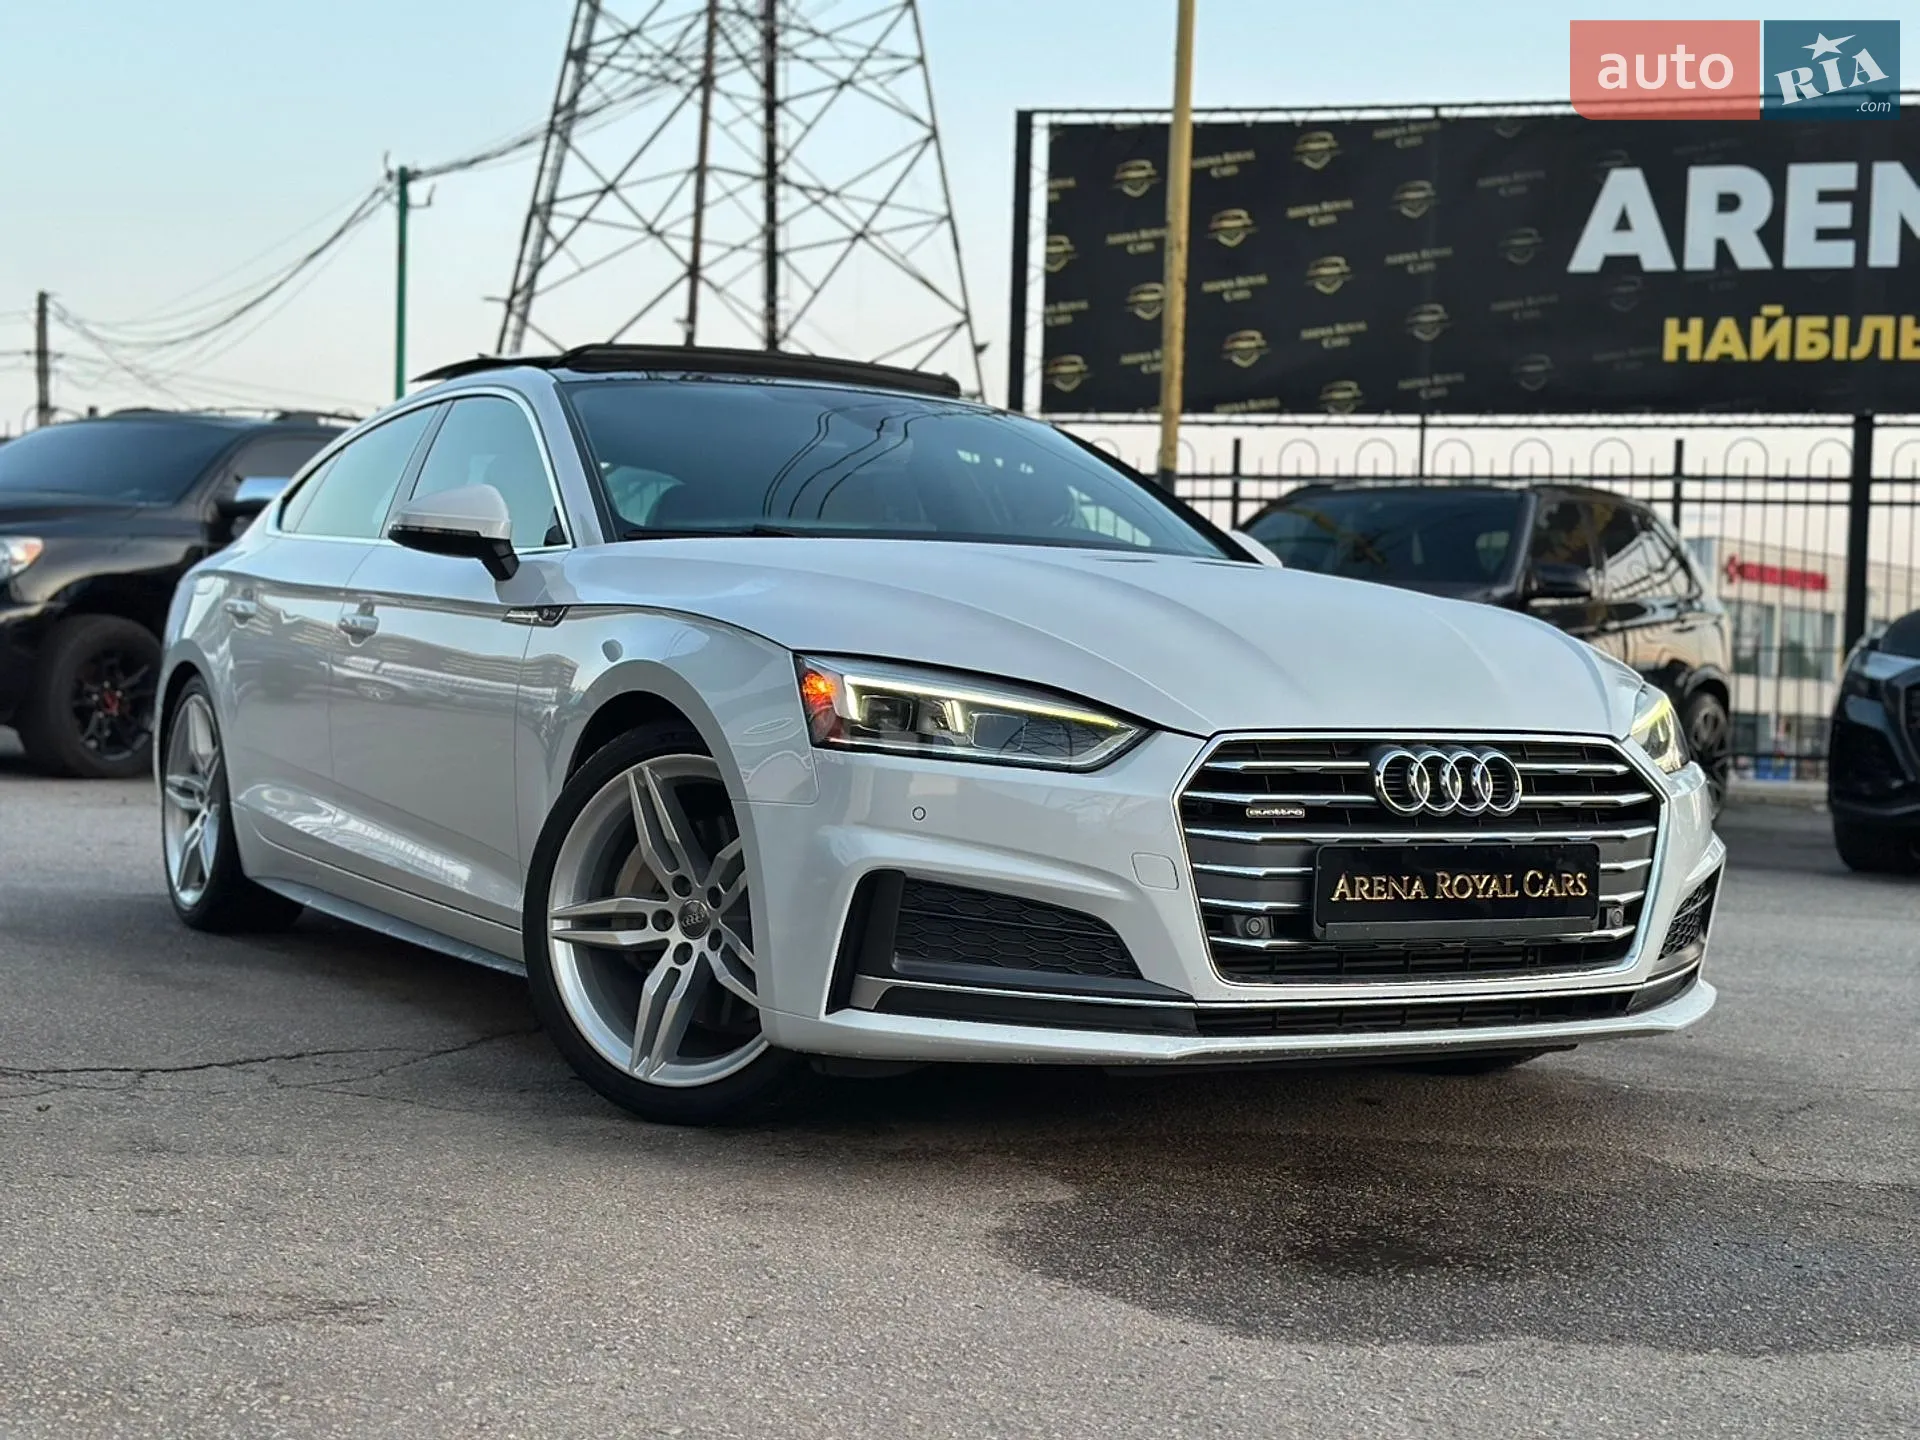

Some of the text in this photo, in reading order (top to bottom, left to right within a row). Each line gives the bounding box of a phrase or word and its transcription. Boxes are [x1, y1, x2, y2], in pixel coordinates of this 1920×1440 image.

[1330, 869, 1589, 901] ARENA ROYAL CARS
